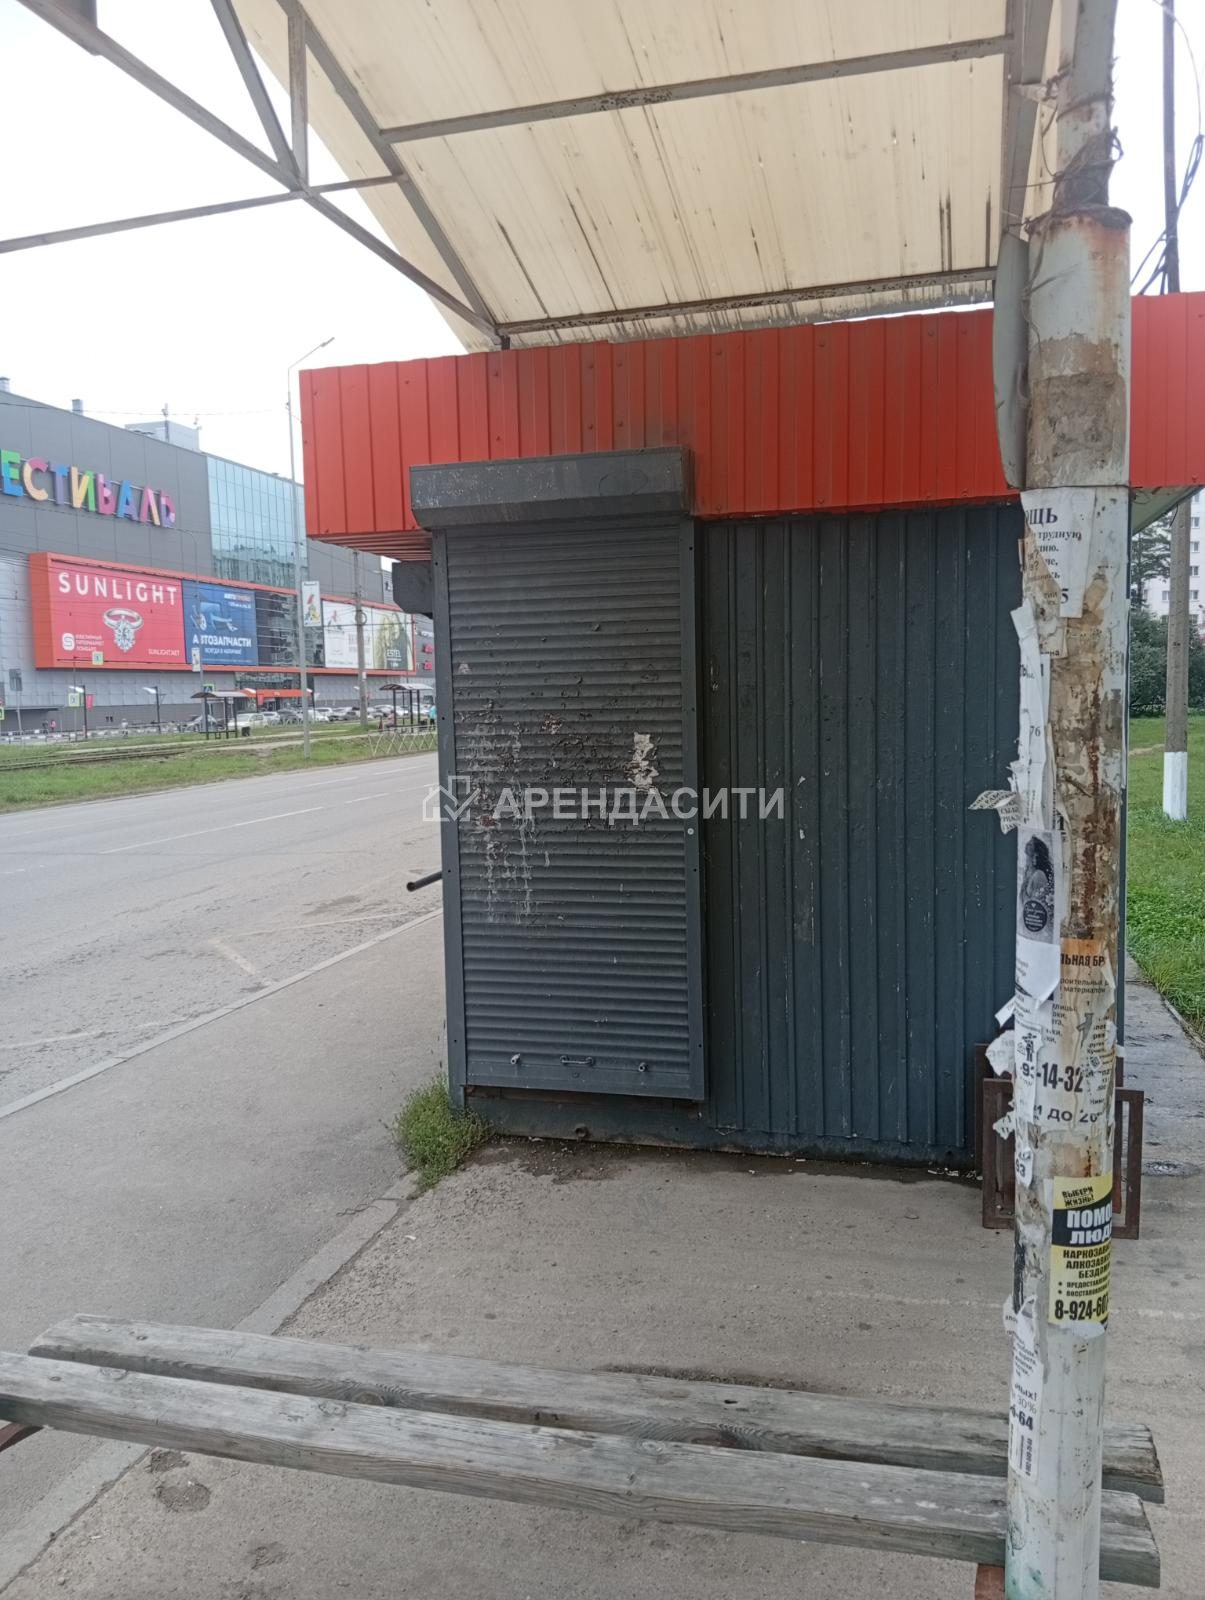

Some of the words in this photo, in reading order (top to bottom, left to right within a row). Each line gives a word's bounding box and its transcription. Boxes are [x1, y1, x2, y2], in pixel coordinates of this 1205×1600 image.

[58, 572, 177, 606] SUNLIGHT
[1062, 1186, 1093, 1198] ВЫБЕРИ
[1064, 1194, 1095, 1207] ЖИЗНЬ!
